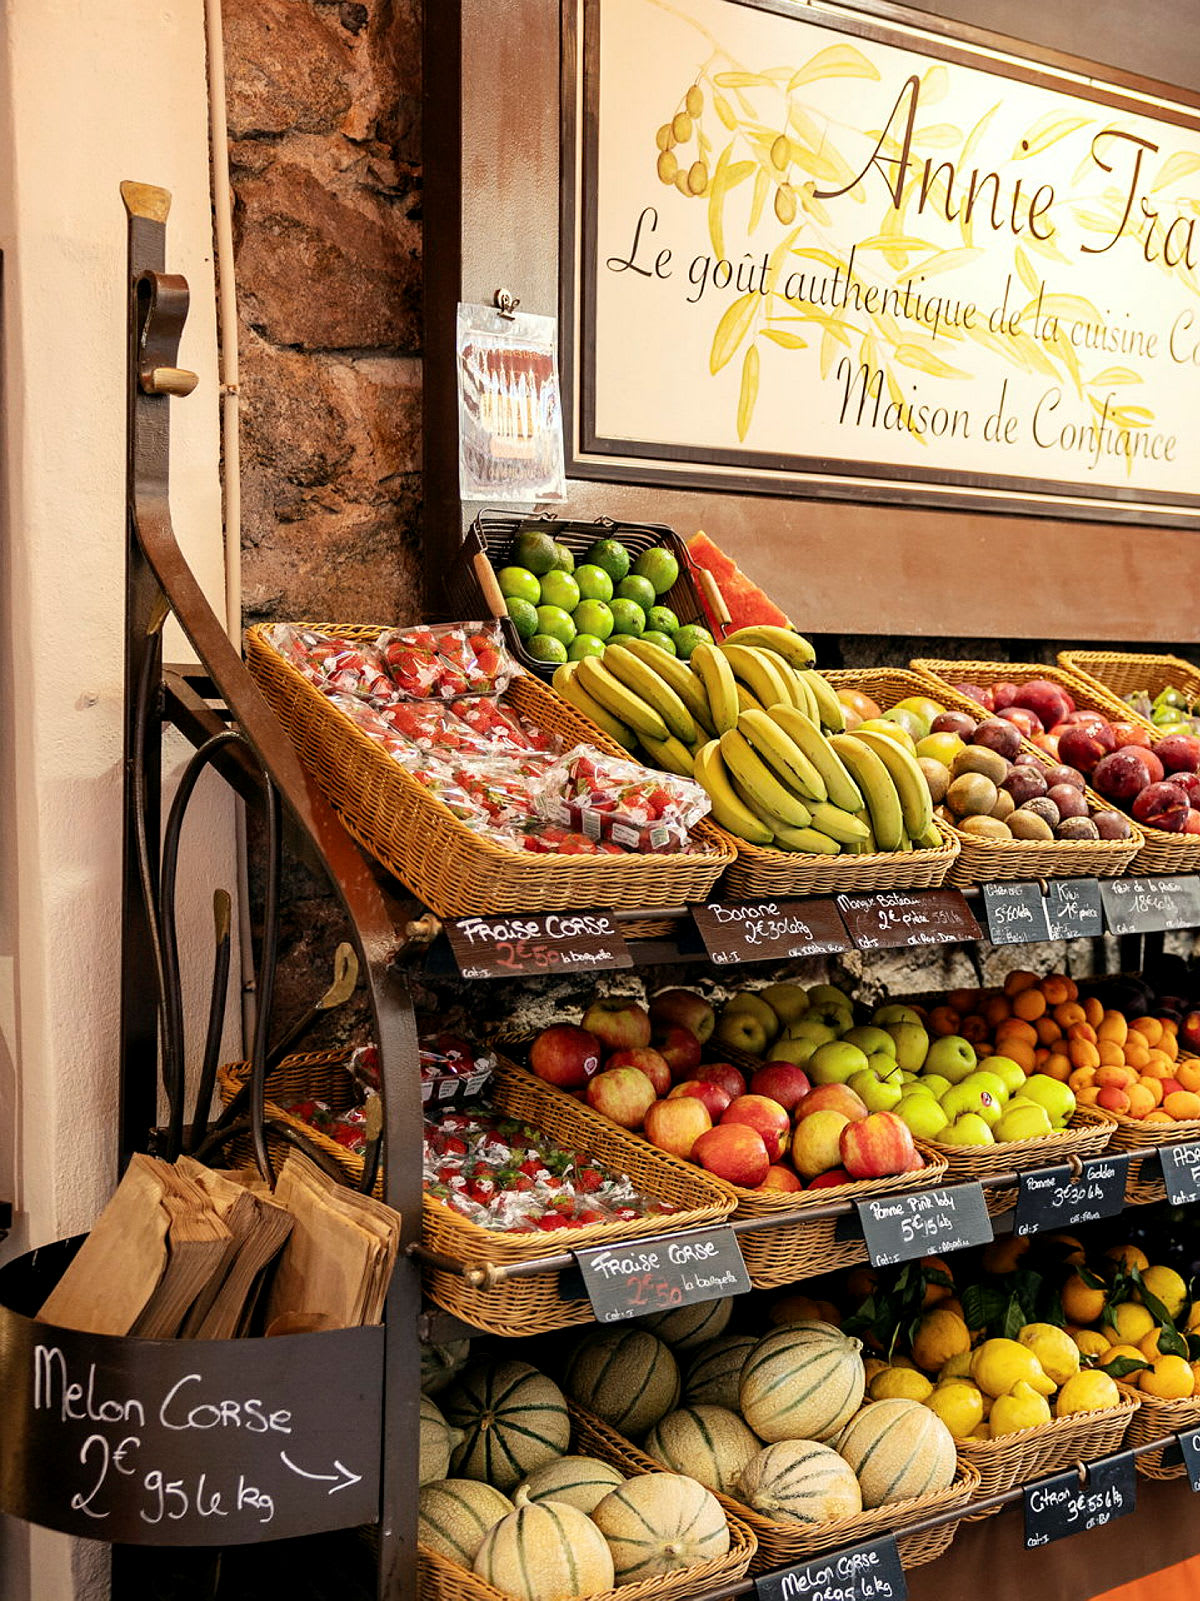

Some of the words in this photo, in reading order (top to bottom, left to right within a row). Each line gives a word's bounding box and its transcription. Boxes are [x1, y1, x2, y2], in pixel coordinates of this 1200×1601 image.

[814, 75, 1056, 242] Annie
[607, 207, 673, 281] Le
[688, 249, 772, 305] goût
[784, 245, 977, 338] authentique
[988, 275, 1025, 338] de
[1032, 296, 1061, 346] la
[1071, 313, 1159, 361] cuisine
[837, 356, 972, 439] Maison
[983, 378, 1019, 445] de
[1032, 388, 1178, 473] Confiance
[707, 903, 781, 923] Banane
[1087, 1164, 1115, 1180] Golden
[33, 1344, 145, 1428] Melon
[70, 1433, 194, 1524] 2€95
[236, 1475, 275, 1523] kg
[780, 1566, 834, 1601] Melon
